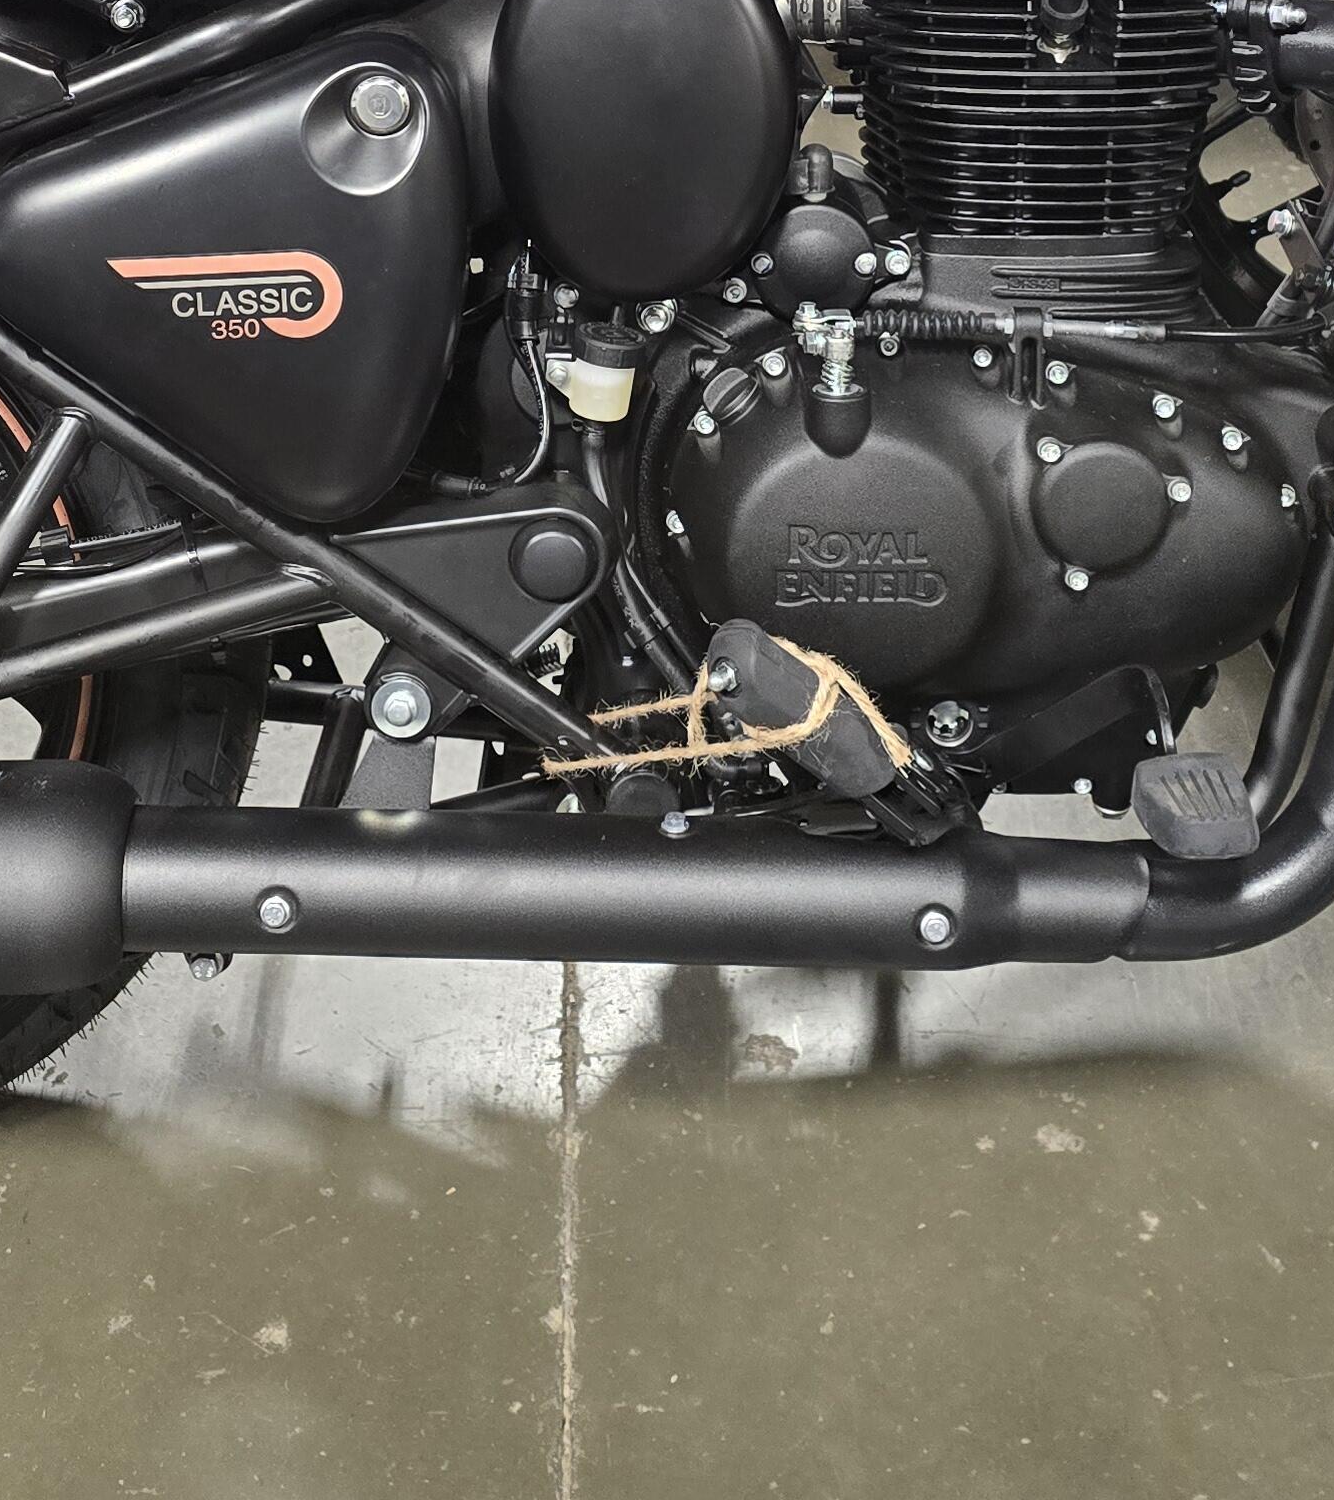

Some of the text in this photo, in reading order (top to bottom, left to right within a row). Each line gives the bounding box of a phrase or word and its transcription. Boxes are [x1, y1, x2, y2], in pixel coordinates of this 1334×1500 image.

[171, 286, 313, 318] CLASSIC
[211, 318, 261, 340] 350
[787, 524, 928, 569] ROYAL
[775, 568, 948, 608] ENFIELD
